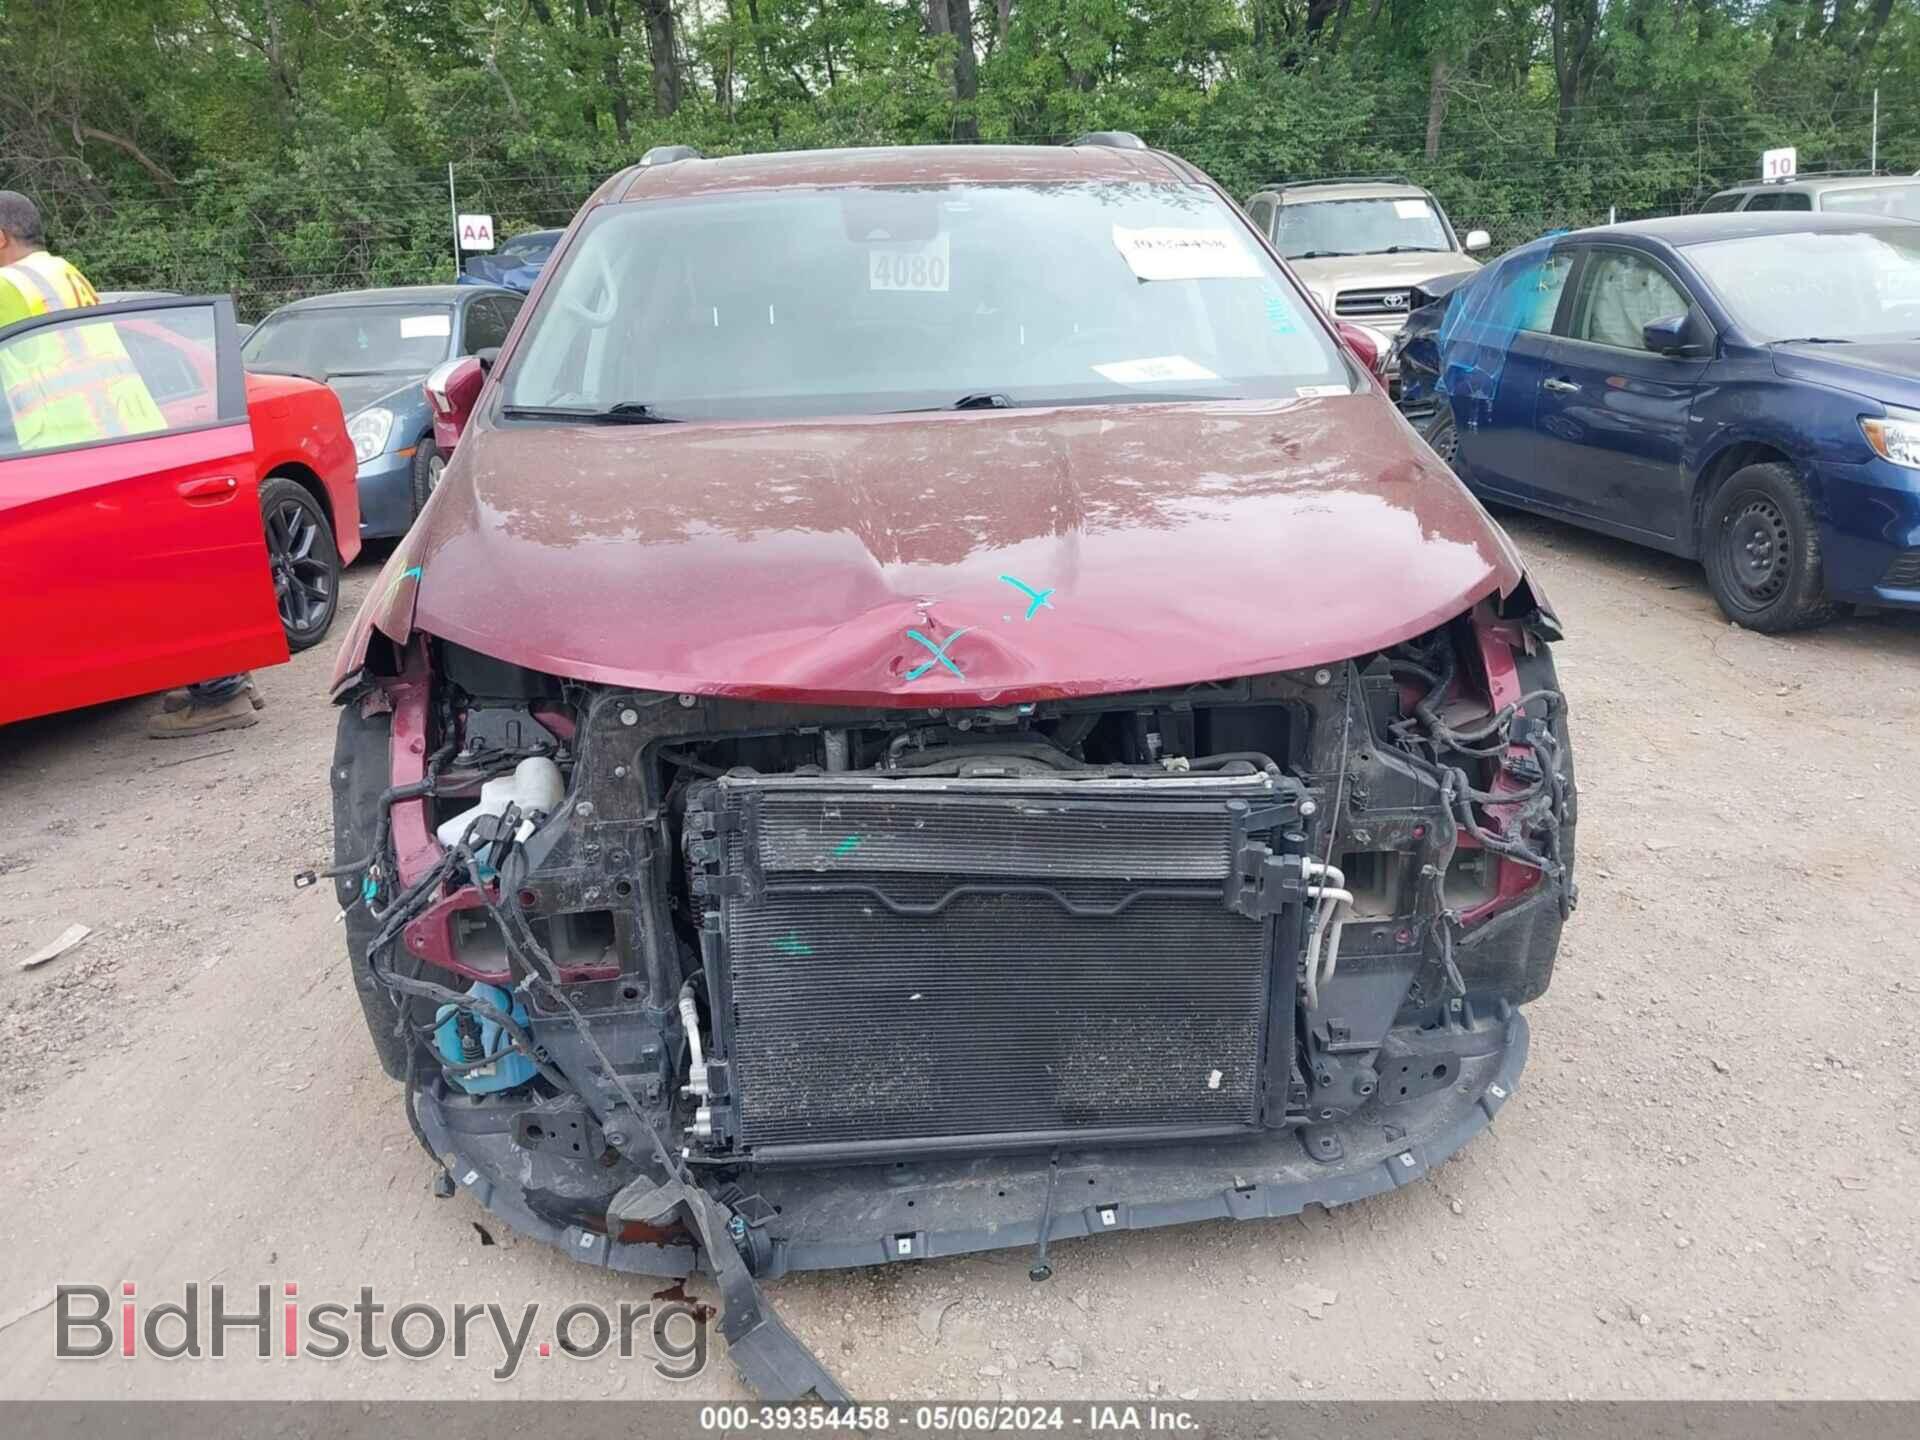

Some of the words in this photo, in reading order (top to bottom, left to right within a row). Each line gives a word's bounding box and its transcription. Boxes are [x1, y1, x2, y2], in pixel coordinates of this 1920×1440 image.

[1769, 158, 1791, 176] 10
[464, 225, 490, 240] AA
[872, 255, 945, 288] 4080
